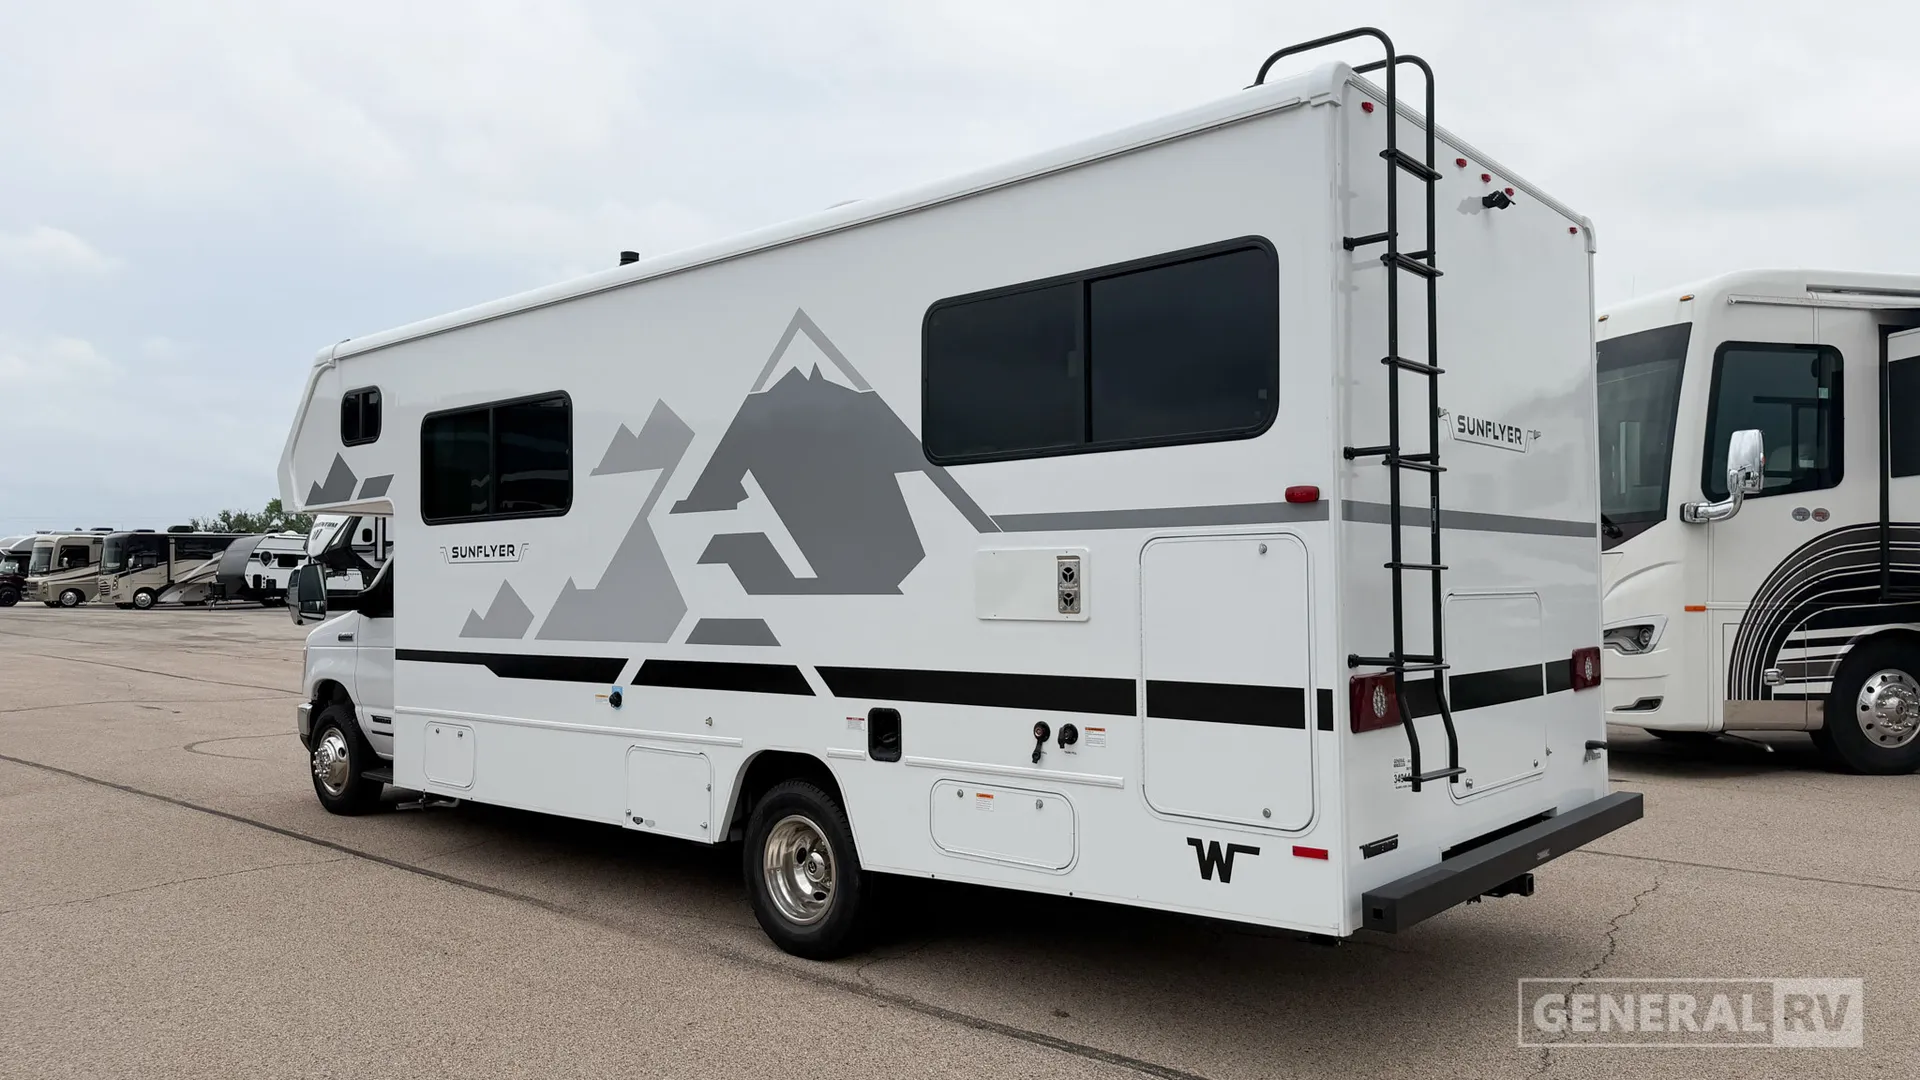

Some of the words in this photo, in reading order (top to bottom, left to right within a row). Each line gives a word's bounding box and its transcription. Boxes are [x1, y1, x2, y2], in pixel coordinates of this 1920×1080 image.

[1457, 414, 1522, 445] SUNFLYER
[451, 544, 515, 559] SUNFLYER
[1186, 837, 1260, 884] W
